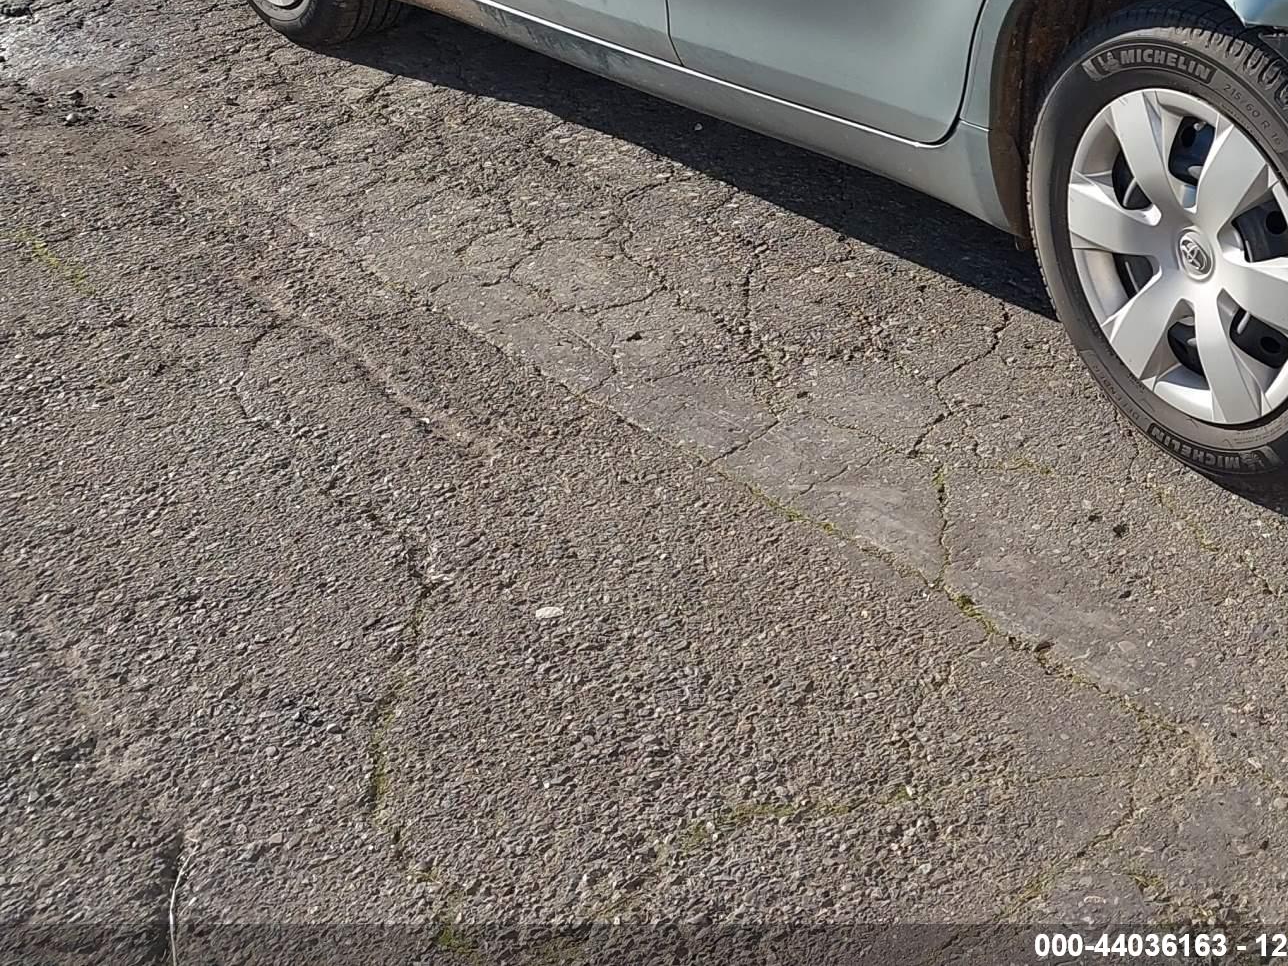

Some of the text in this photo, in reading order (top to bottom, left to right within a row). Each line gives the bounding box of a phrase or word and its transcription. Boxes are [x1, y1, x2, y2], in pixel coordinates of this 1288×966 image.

[1119, 48, 1211, 78] MICHELIN
[1262, 120, 1272, 130] R
[1151, 427, 1241, 470] MICHELIN
